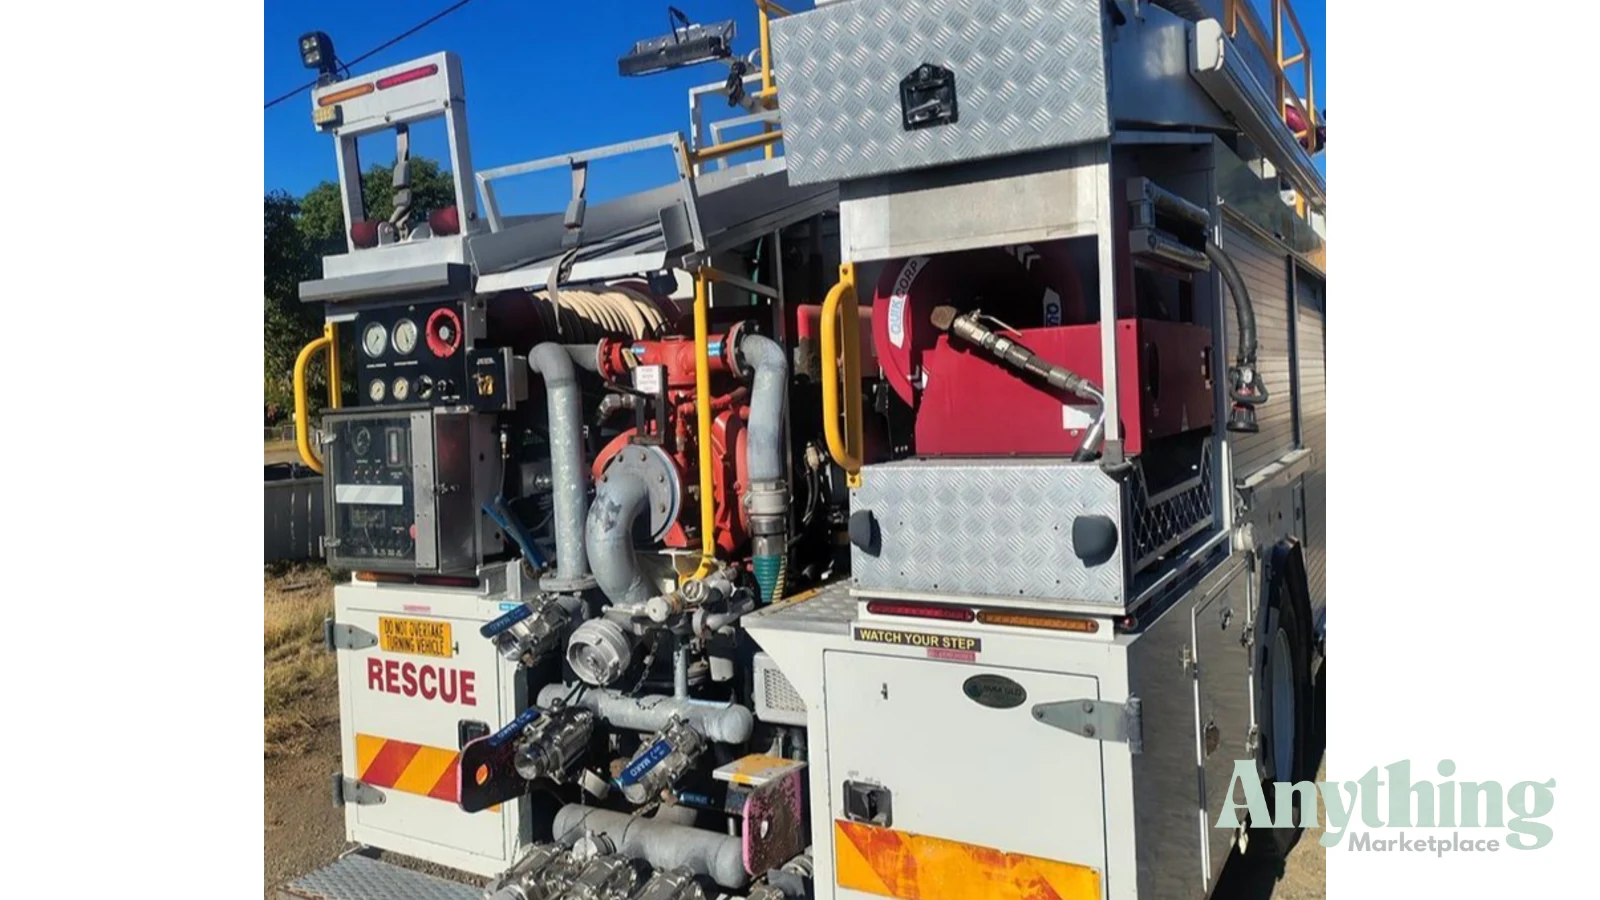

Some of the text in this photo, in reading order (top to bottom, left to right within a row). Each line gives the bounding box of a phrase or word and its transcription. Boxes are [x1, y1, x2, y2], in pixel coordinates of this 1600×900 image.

[891, 260, 918, 335] QUIK CORP
[384, 619, 443, 640] DO NOT OVERTAKE
[859, 629, 975, 651] WATCH YOUR STEP
[386, 635, 445, 656] TURNING VEHICLE
[367, 657, 477, 707] RESCUE
[630, 756, 651, 778] MAKO
